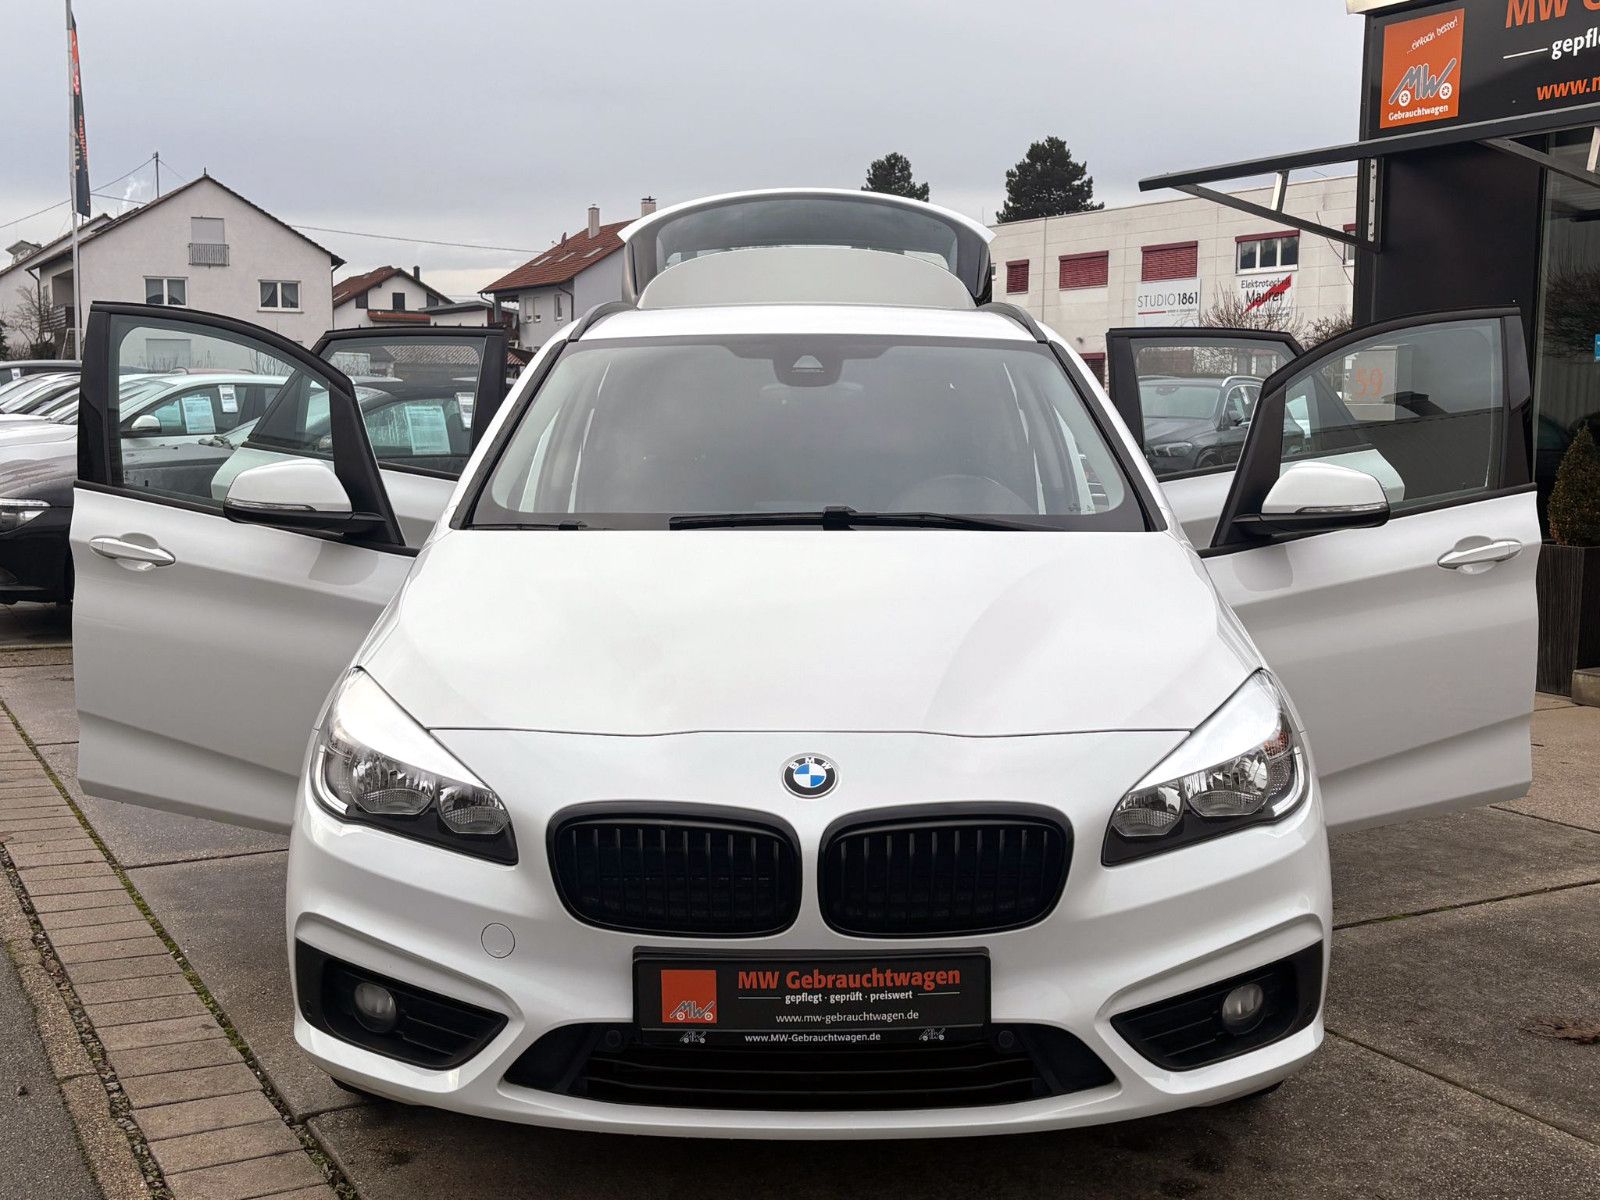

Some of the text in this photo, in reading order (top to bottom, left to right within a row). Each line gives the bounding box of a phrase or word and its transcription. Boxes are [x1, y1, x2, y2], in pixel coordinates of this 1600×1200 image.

[1552, 27, 1600, 60] gepfl
[1389, 58, 1457, 106] MW
[1388, 104, 1448, 121] Gebrauchtwagen
[788, 756, 832, 770] BMW
[738, 968, 960, 991] MW Gebrauchtwagen
[785, 990, 913, 1005] gepflegt geprüft preiswert
[670, 1000, 716, 1020] MW
[775, 1010, 919, 1024] www.mw-gebrauchtwagen.de
[744, 1032, 881, 1043] www.MW-Gebrauchtwagen.de
